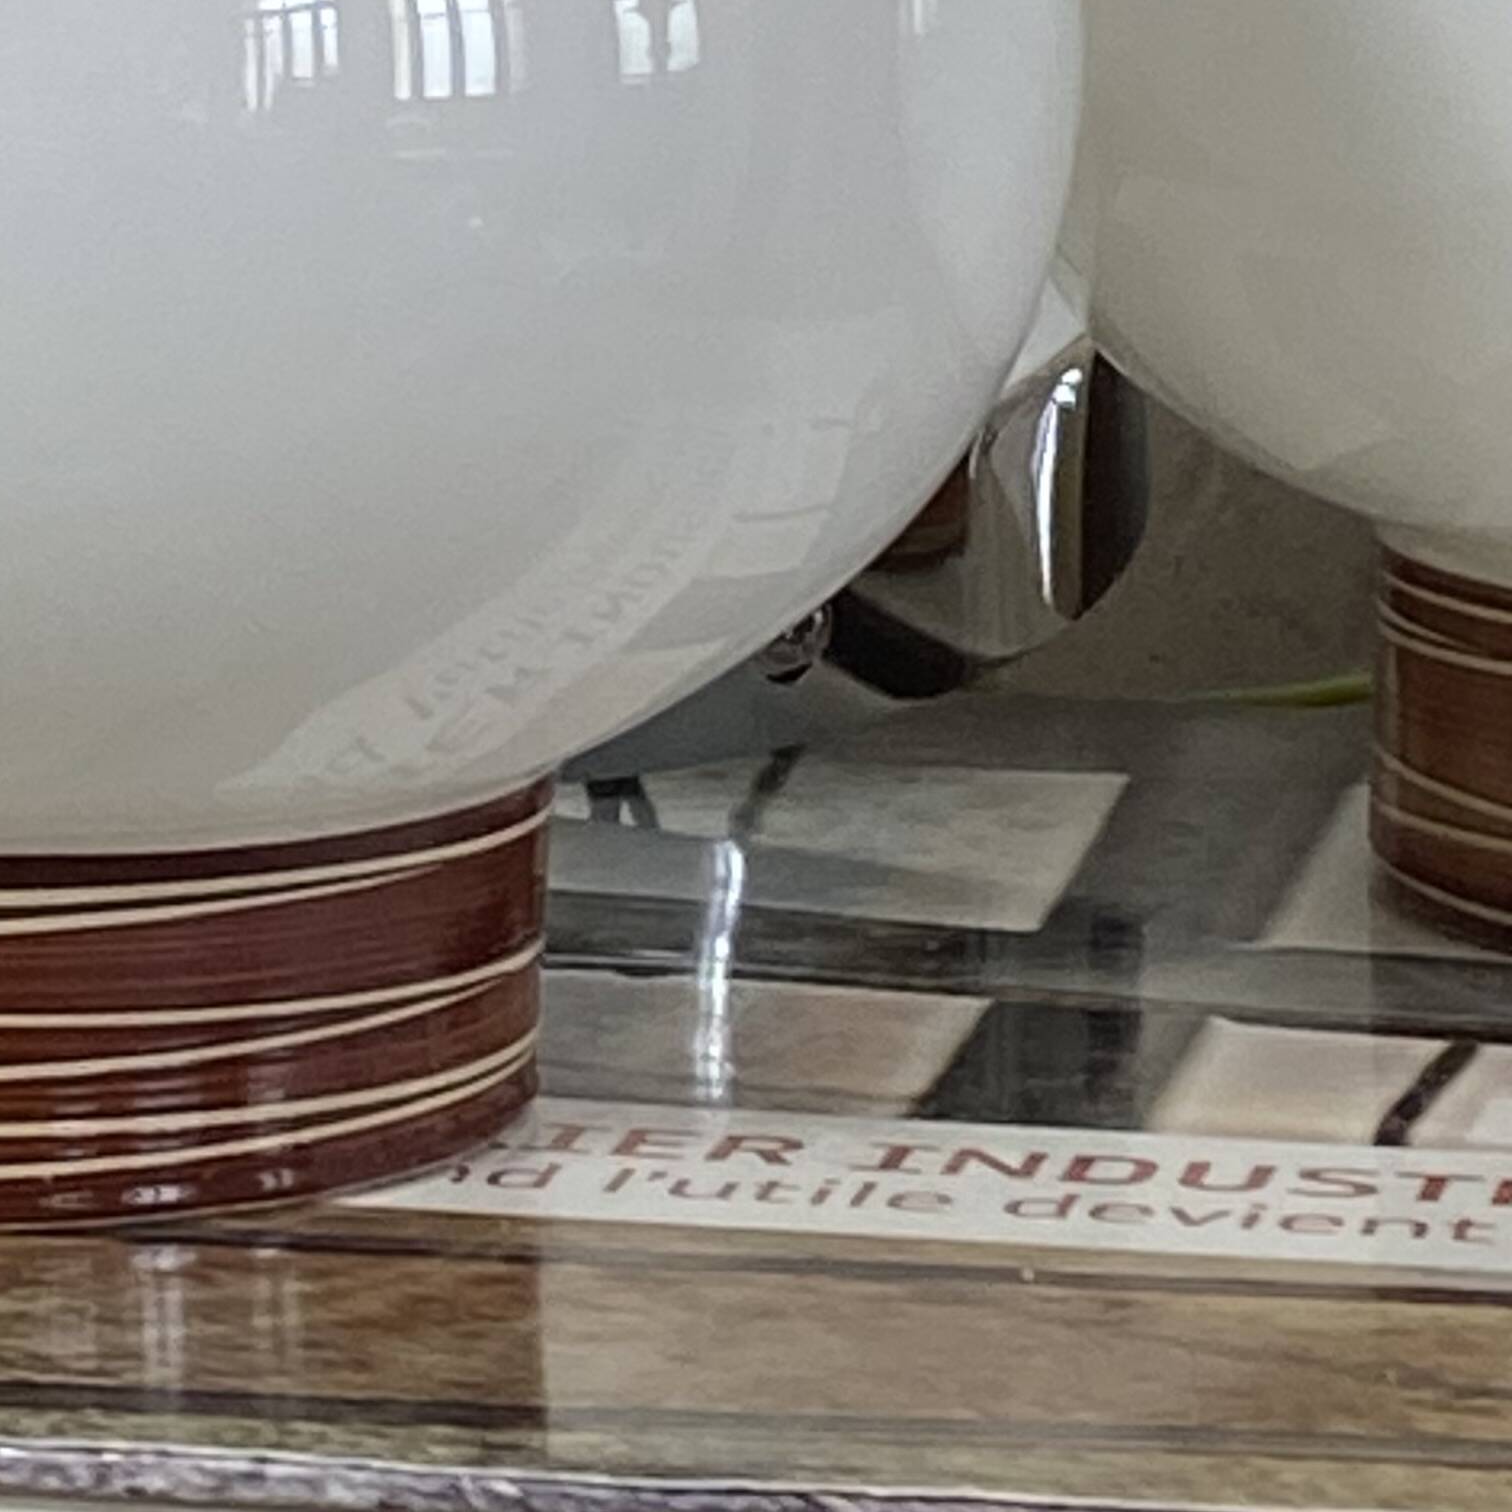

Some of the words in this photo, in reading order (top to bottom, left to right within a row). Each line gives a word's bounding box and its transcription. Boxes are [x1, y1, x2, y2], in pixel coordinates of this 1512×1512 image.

[489, 1122, 805, 1166] IER
[849, 1142, 1512, 1205] INDUST
[602, 1168, 953, 1214] l'utile
[1003, 1192, 1496, 1246] devient
